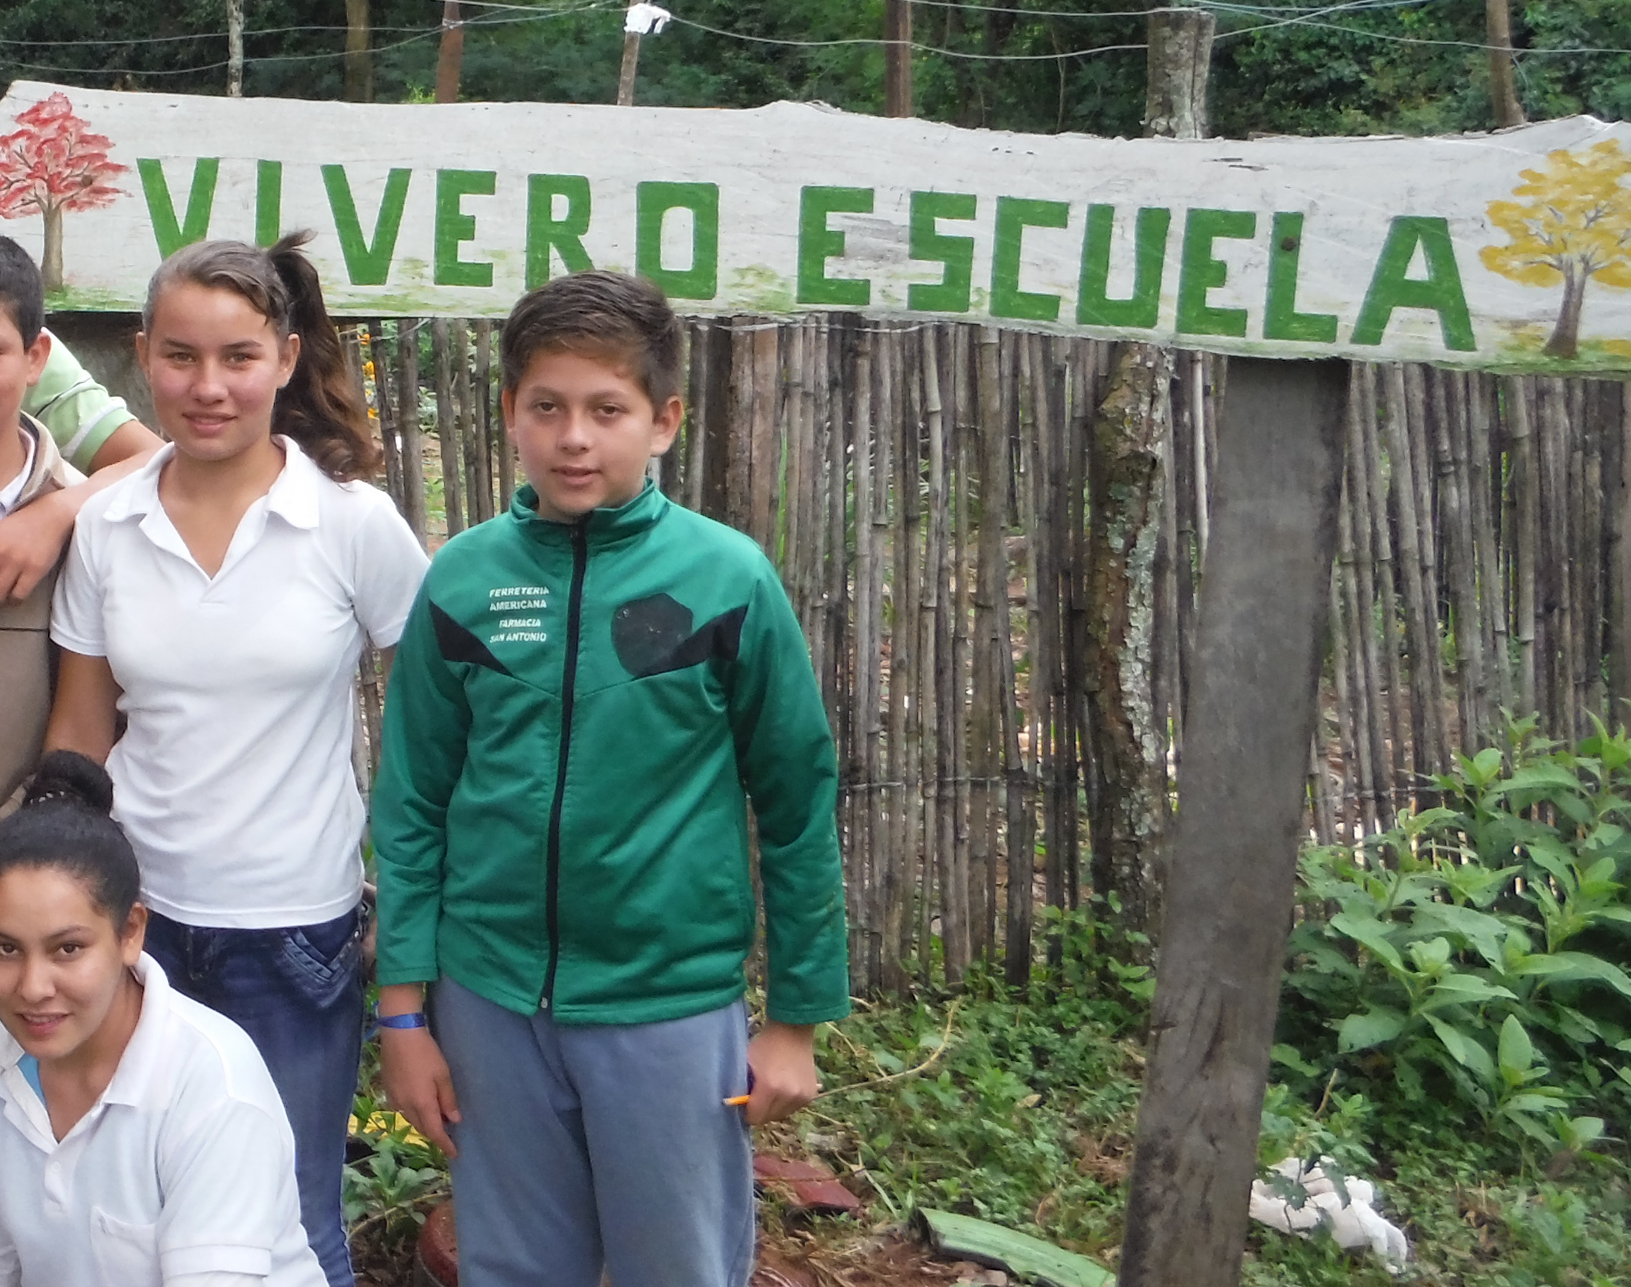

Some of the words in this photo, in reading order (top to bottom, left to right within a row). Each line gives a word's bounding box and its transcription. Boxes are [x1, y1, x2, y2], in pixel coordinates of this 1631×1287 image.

[136, 157, 721, 300] VIVERO
[796, 186, 1479, 352] ESCUELA
[489, 586, 550, 598] FERRETERIA
[489, 599, 548, 611] AMERICANA
[498, 618, 542, 629] FARMACIA
[489, 633, 505, 644] SAN
[505, 631, 547, 642] ANTONIO
